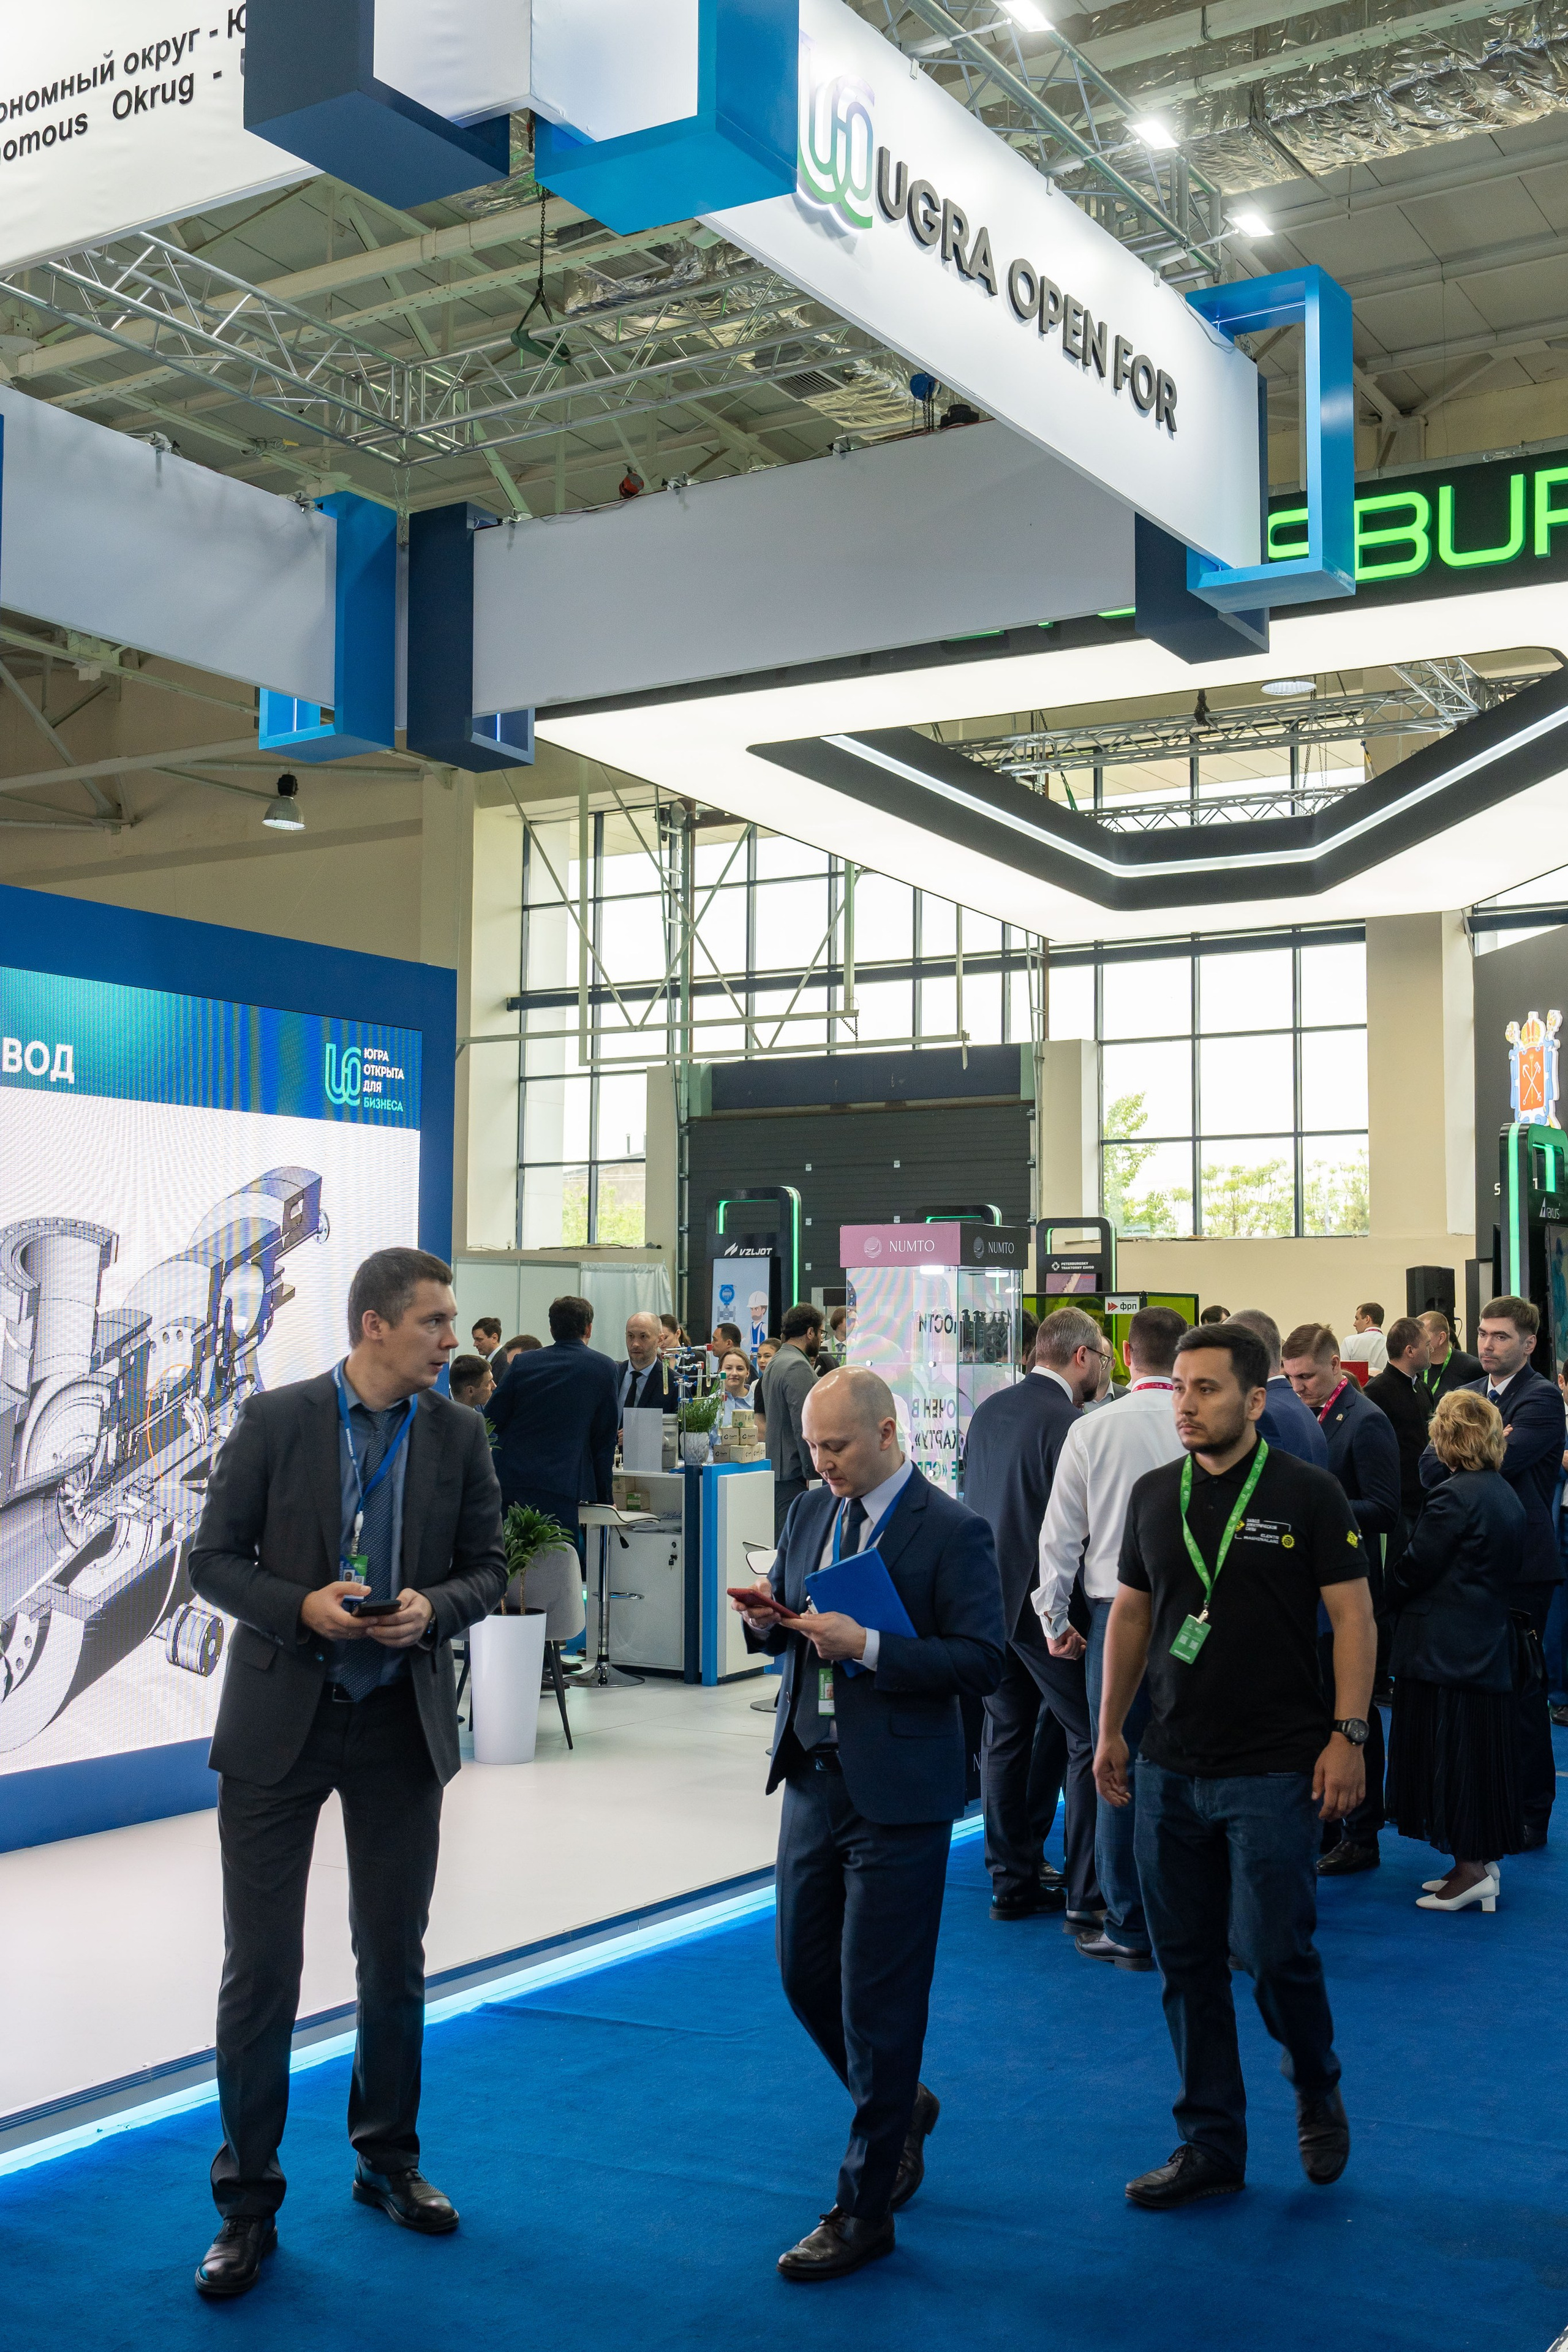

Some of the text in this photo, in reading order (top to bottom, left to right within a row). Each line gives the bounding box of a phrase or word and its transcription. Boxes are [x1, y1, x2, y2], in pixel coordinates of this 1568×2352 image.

[123, 28, 200, 74] округ
[0, 113, 88, 164] omous
[113, 72, 195, 121] Okrug
[877, 146, 1178, 433] UGRA OPEN FOR
[2, 1036, 75, 1084] ВОД
[363, 1047, 390, 1061] ЮГРА
[363, 1063, 404, 1080] ОТКРЫТА
[363, 1080, 382, 1093] ДЛЯ
[363, 1096, 404, 1112] БИЗНЕСА
[739, 1248, 773, 1256] VZLJOT
[889, 1240, 935, 1253] NUMTO
[988, 1242, 1015, 1254] NUMTO
[1120, 1302, 1137, 1311] фрп
